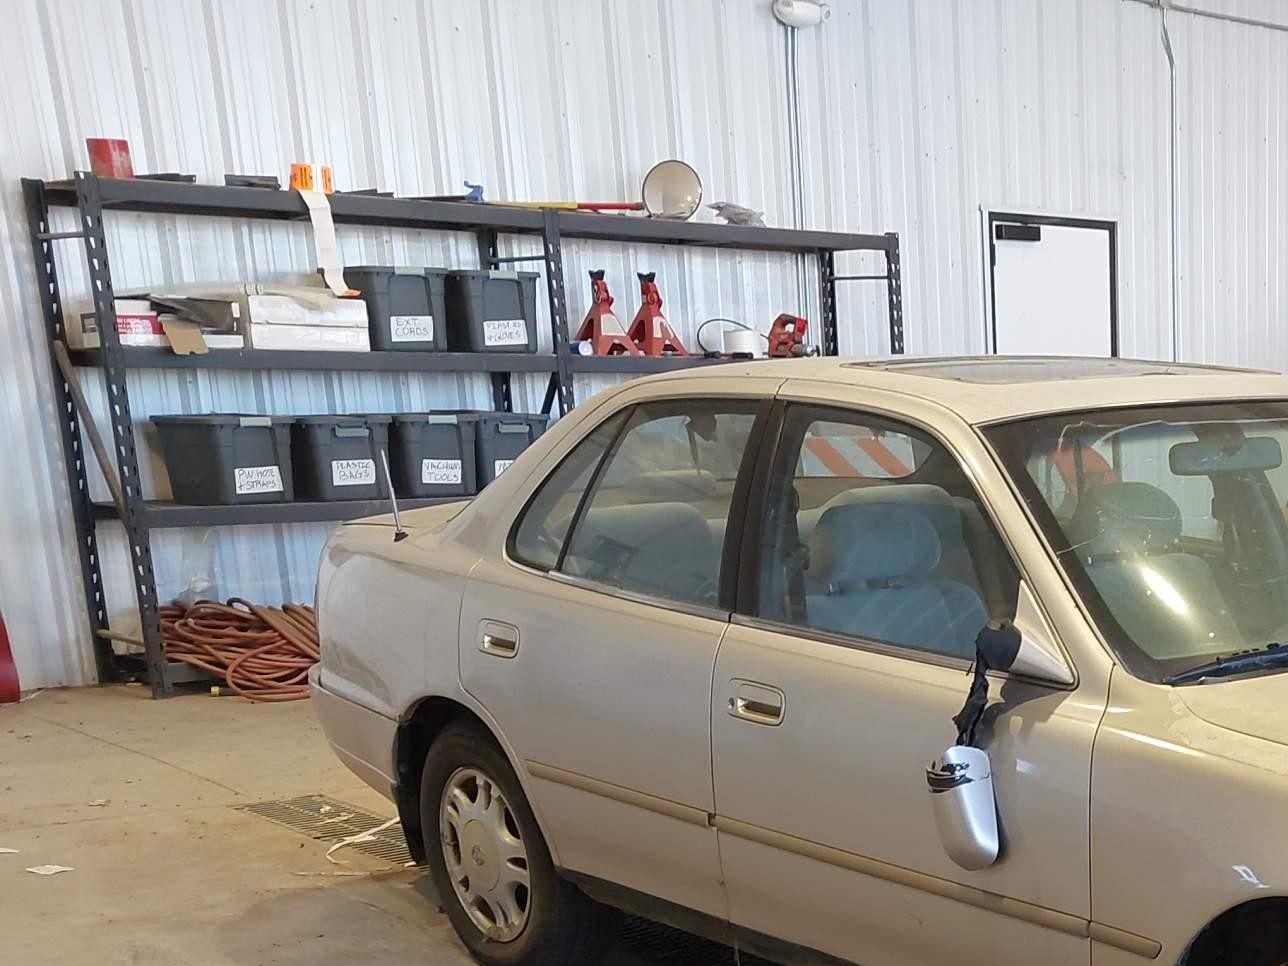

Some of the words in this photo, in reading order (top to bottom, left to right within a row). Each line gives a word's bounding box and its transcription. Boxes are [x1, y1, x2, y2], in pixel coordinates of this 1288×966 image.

[395, 317, 419, 327] EXT
[395, 327, 430, 337] CORDS
[336, 461, 371, 470] PLASTIC
[339, 469, 370, 481] BAGS
[427, 471, 459, 482] TOOLS
